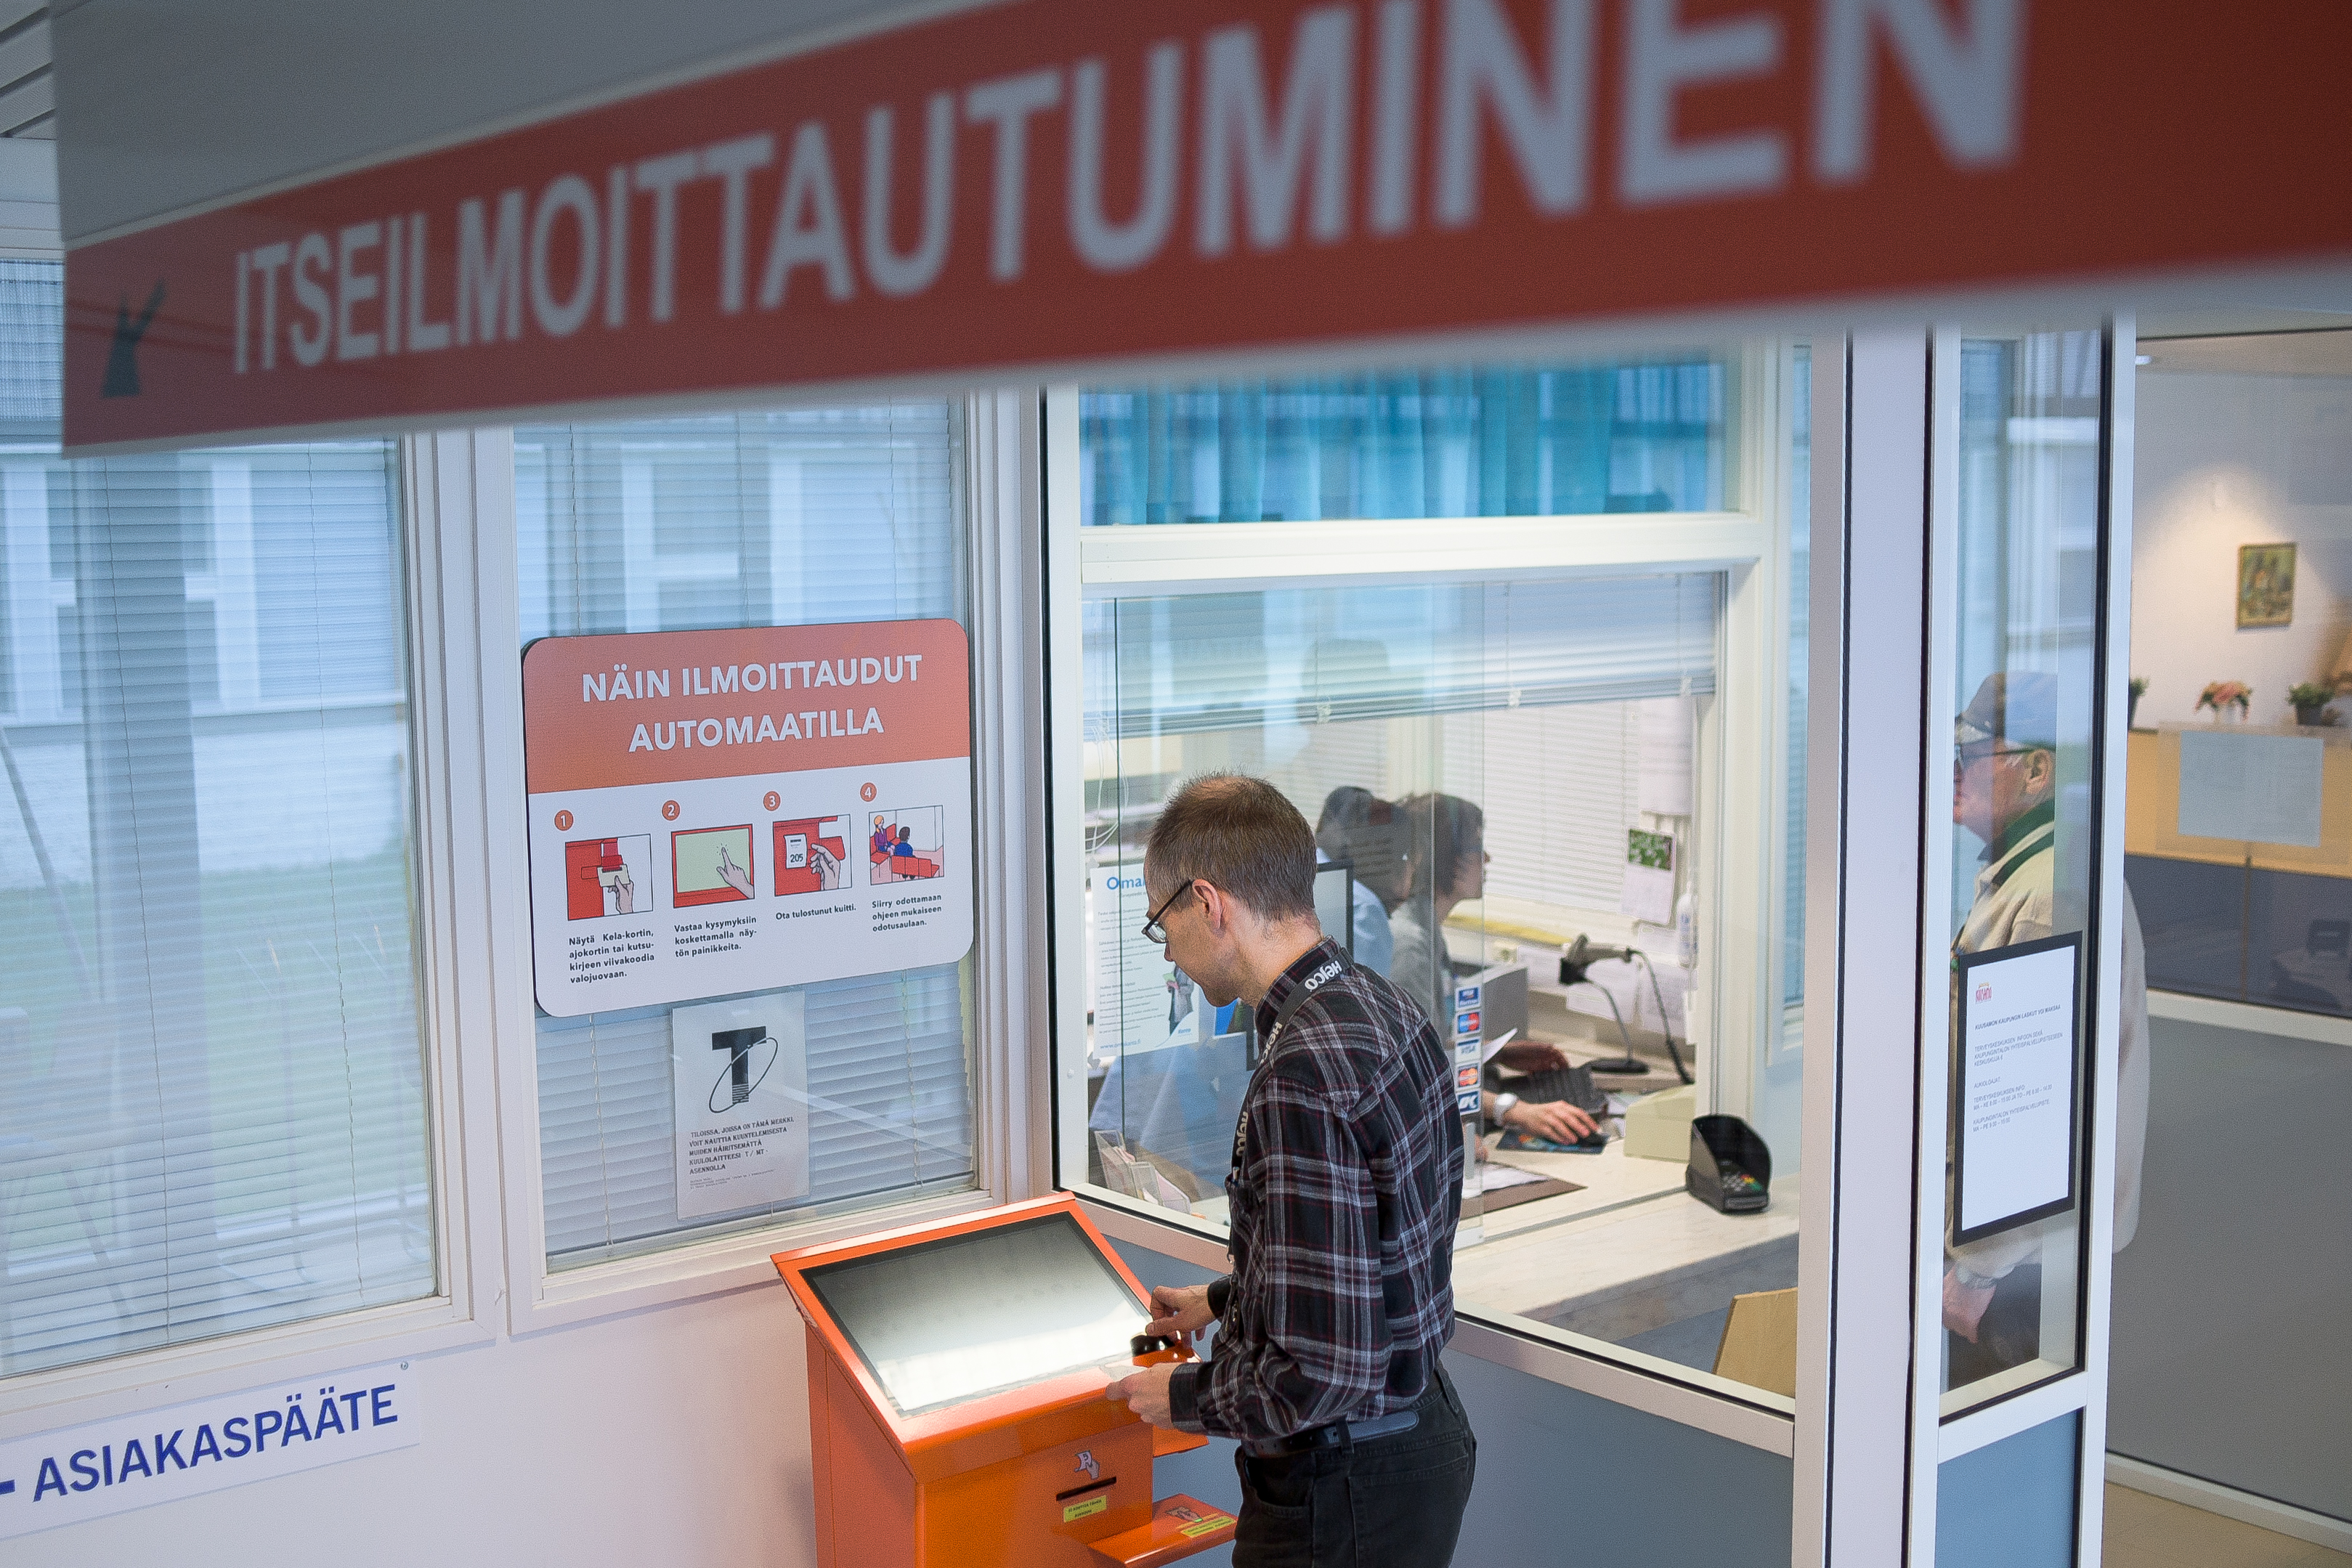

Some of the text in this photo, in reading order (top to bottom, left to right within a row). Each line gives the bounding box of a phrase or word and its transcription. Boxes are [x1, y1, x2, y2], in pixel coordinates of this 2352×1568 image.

[234, 0, 2028, 373] ITSEILMOITTAUTUMINEN
[583, 654, 922, 702] NÄIN ILMOITTAUDUT
[629, 707, 884, 752] AUTOMAATILLA
[790, 853, 804, 863] 205
[1106, 876, 1145, 890] Oma
[872, 894, 942, 910] Siirry odottamaan
[776, 903, 856, 920] Ota tulostunut kuitti.
[872, 906, 942, 922] ohjeen mukaiseen
[674, 916, 757, 933] Vastaa kysymyksiin
[872, 919, 927, 932] odotusaulaan.
[569, 929, 654, 946] Näytä Kela-kortin,
[675, 929, 758, 945] koskettamalla näy-
[569, 941, 654, 959] ajokortin tai kutsu-
[675, 943, 742, 958] tön painikkeita.
[569, 953, 654, 972] kirjeen viivakoodia
[570, 970, 627, 983] valojuovaan.
[691, 1129, 720, 1138] TILOISSA,
[721, 1125, 742, 1134] JOISSA
[752, 1119, 769, 1128] TÄMÄ
[771, 1116, 795, 1125] MERKKI,
[705, 1136, 731, 1145] NAUTTIA
[733, 1126, 787, 1140] KUUNTELEMISESTA
[689, 1140, 762, 1156] MUIDEN HÄIRITSEMÄTTÄ
[689, 1153, 741, 1166] KUULOLAITTEESI
[689, 1163, 726, 1174] ASENNOLLA
[33, 1384, 398, 1502] ASIAKASPÄÄTE
